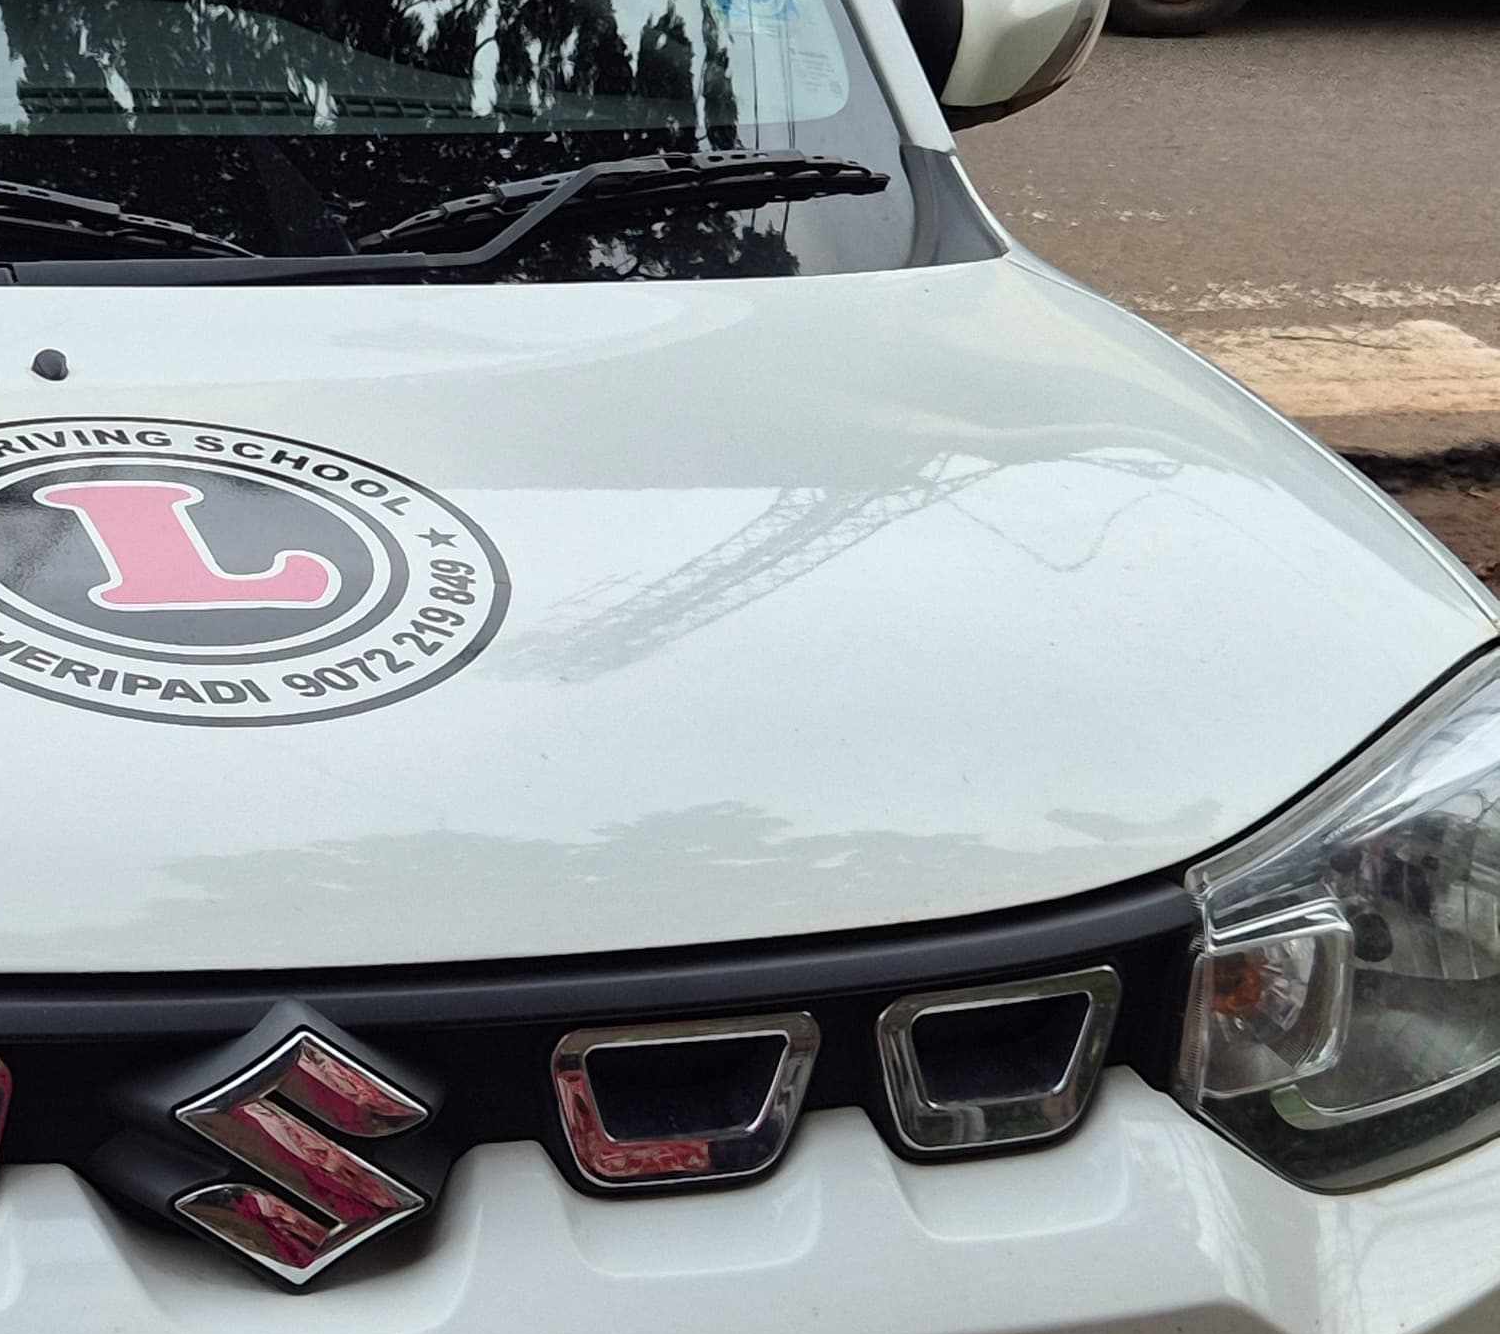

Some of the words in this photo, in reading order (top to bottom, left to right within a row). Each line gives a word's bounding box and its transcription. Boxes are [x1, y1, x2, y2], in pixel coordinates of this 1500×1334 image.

[193, 434, 416, 517] SCHOOL
[41, 484, 331, 604] L
[428, 558, 477, 607] 849
[392, 607, 467, 658] 219
[282, 647, 414, 699] 9072
